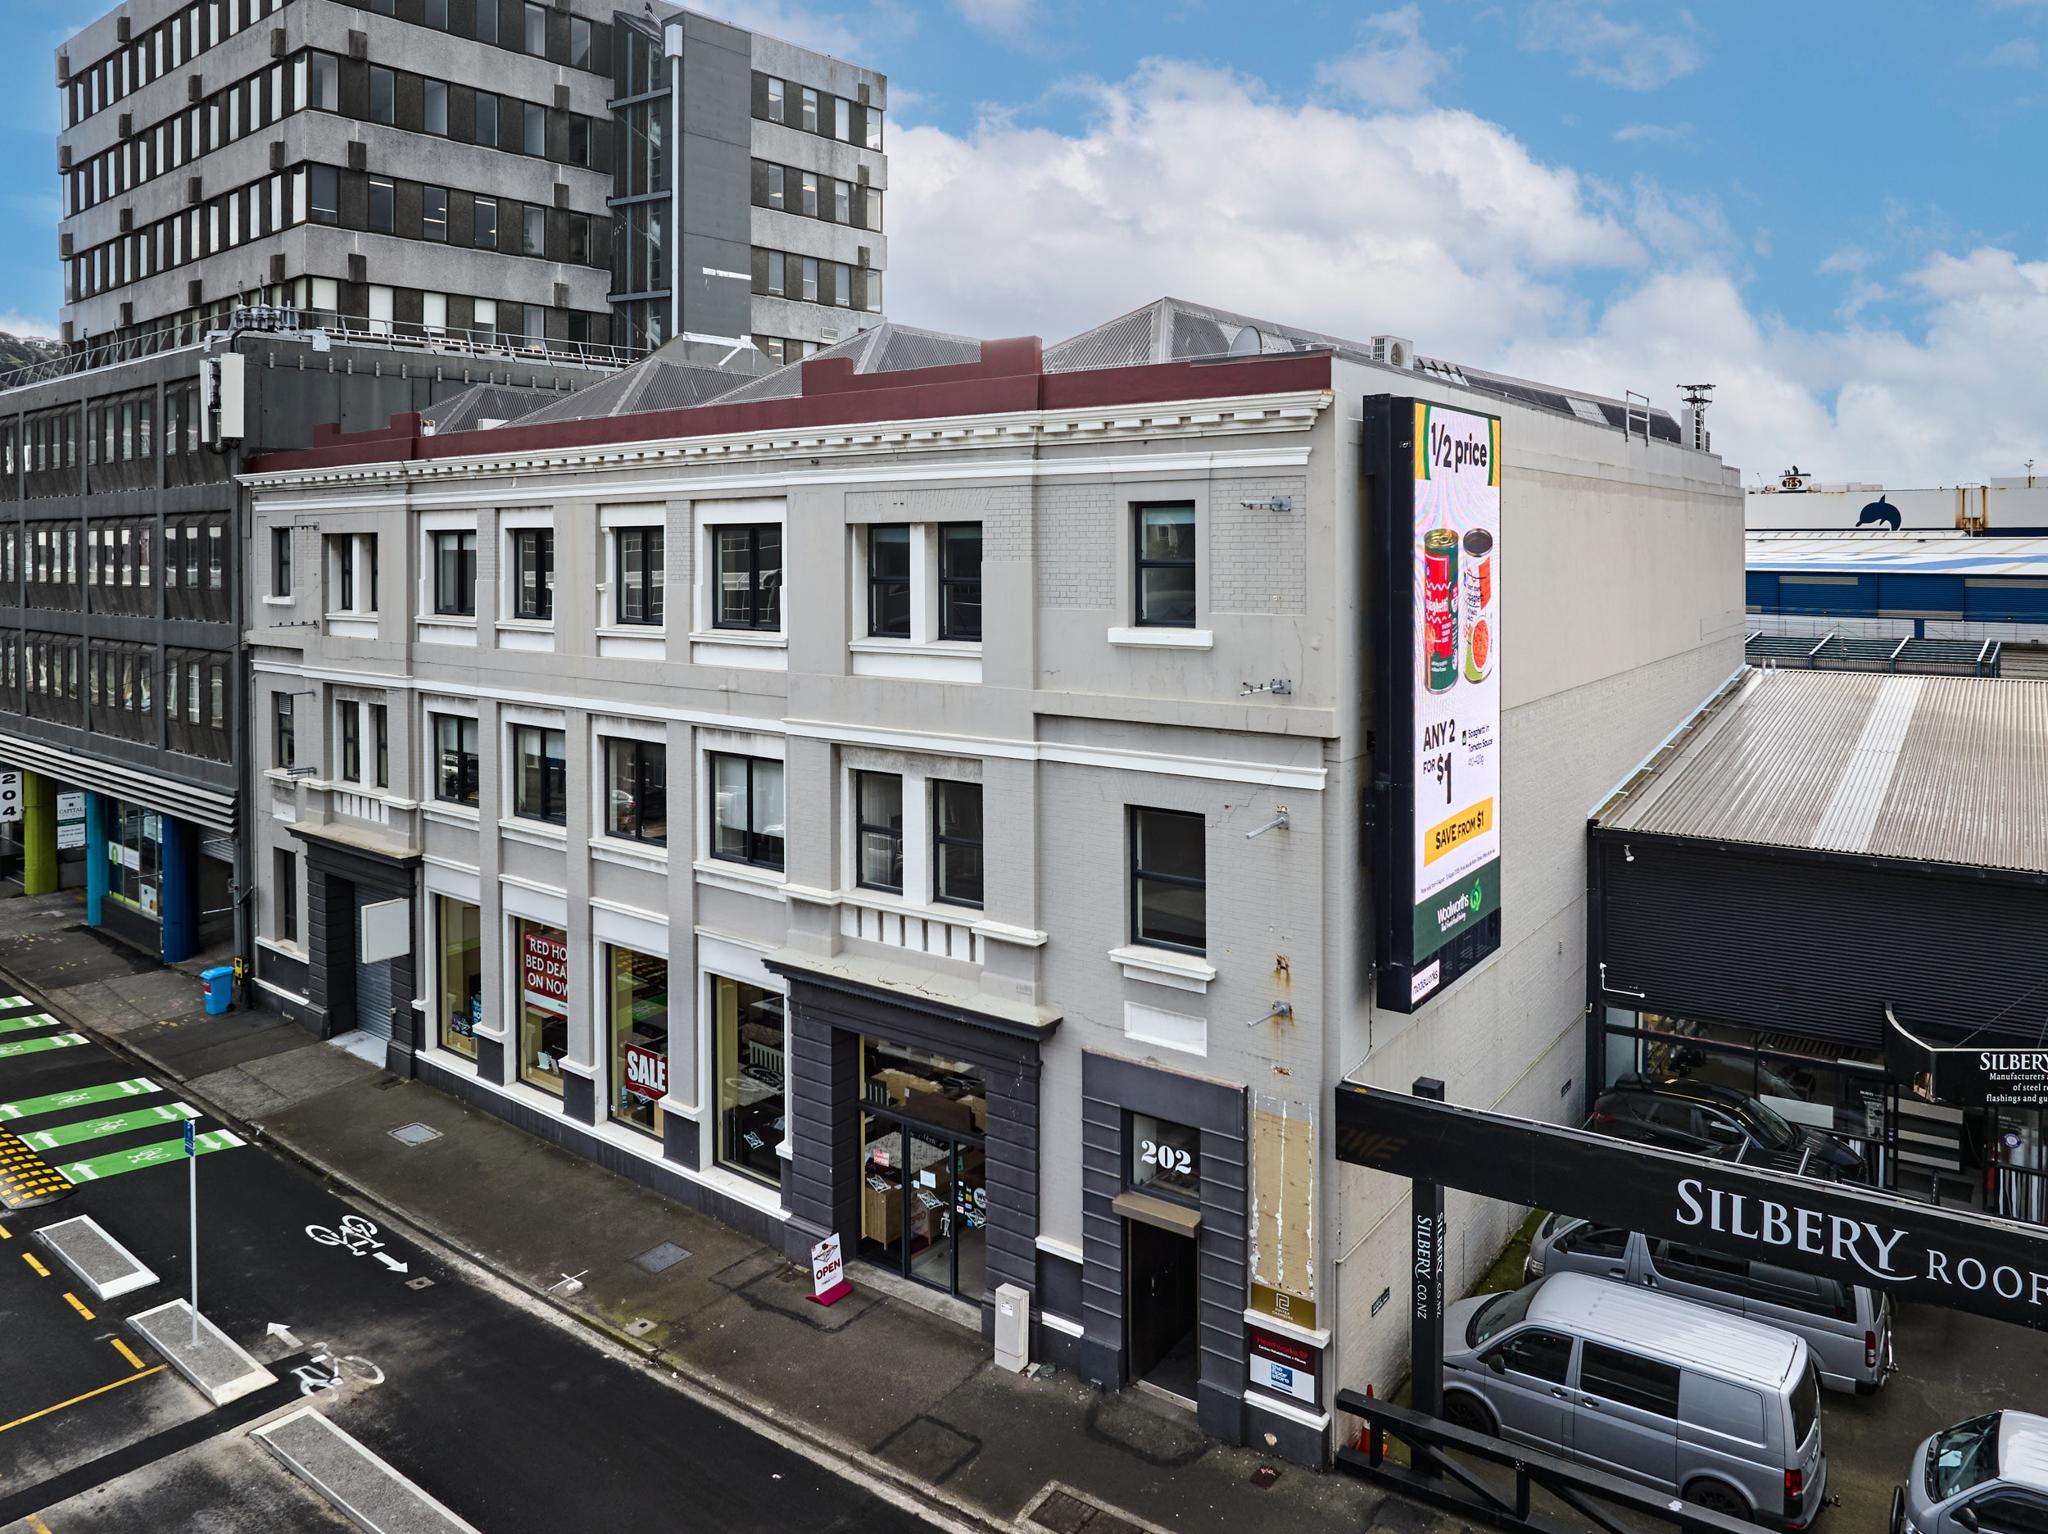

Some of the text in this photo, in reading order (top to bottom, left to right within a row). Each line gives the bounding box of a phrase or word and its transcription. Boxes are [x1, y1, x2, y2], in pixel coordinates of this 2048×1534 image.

[1455, 432, 1487, 473] price
[1423, 718, 1455, 752] ANY 2
[2, 774, 17, 816] 204
[1423, 752, 1452, 805] FOR $1
[1435, 809, 1484, 850] SAVE FROM $1
[1437, 893, 1469, 926] Woolworths
[530, 938, 567, 961] RED HO
[526, 954, 567, 979] BED DEA
[527, 972, 544, 989] ON
[627, 1050, 666, 1092] SALE
[1989, 1072, 2045, 1081] Manufacturers
[2012, 1083, 2022, 1091] of
[2022, 1083, 2041, 1091] steel
[1986, 1094, 2021, 1104] flashings
[2038, 1096, 2048, 1104] gu
[1141, 1140, 1192, 1175] 202
[1675, 1178, 2048, 1306] SILBERY ROOF
[815, 1258, 841, 1280] OPEN
